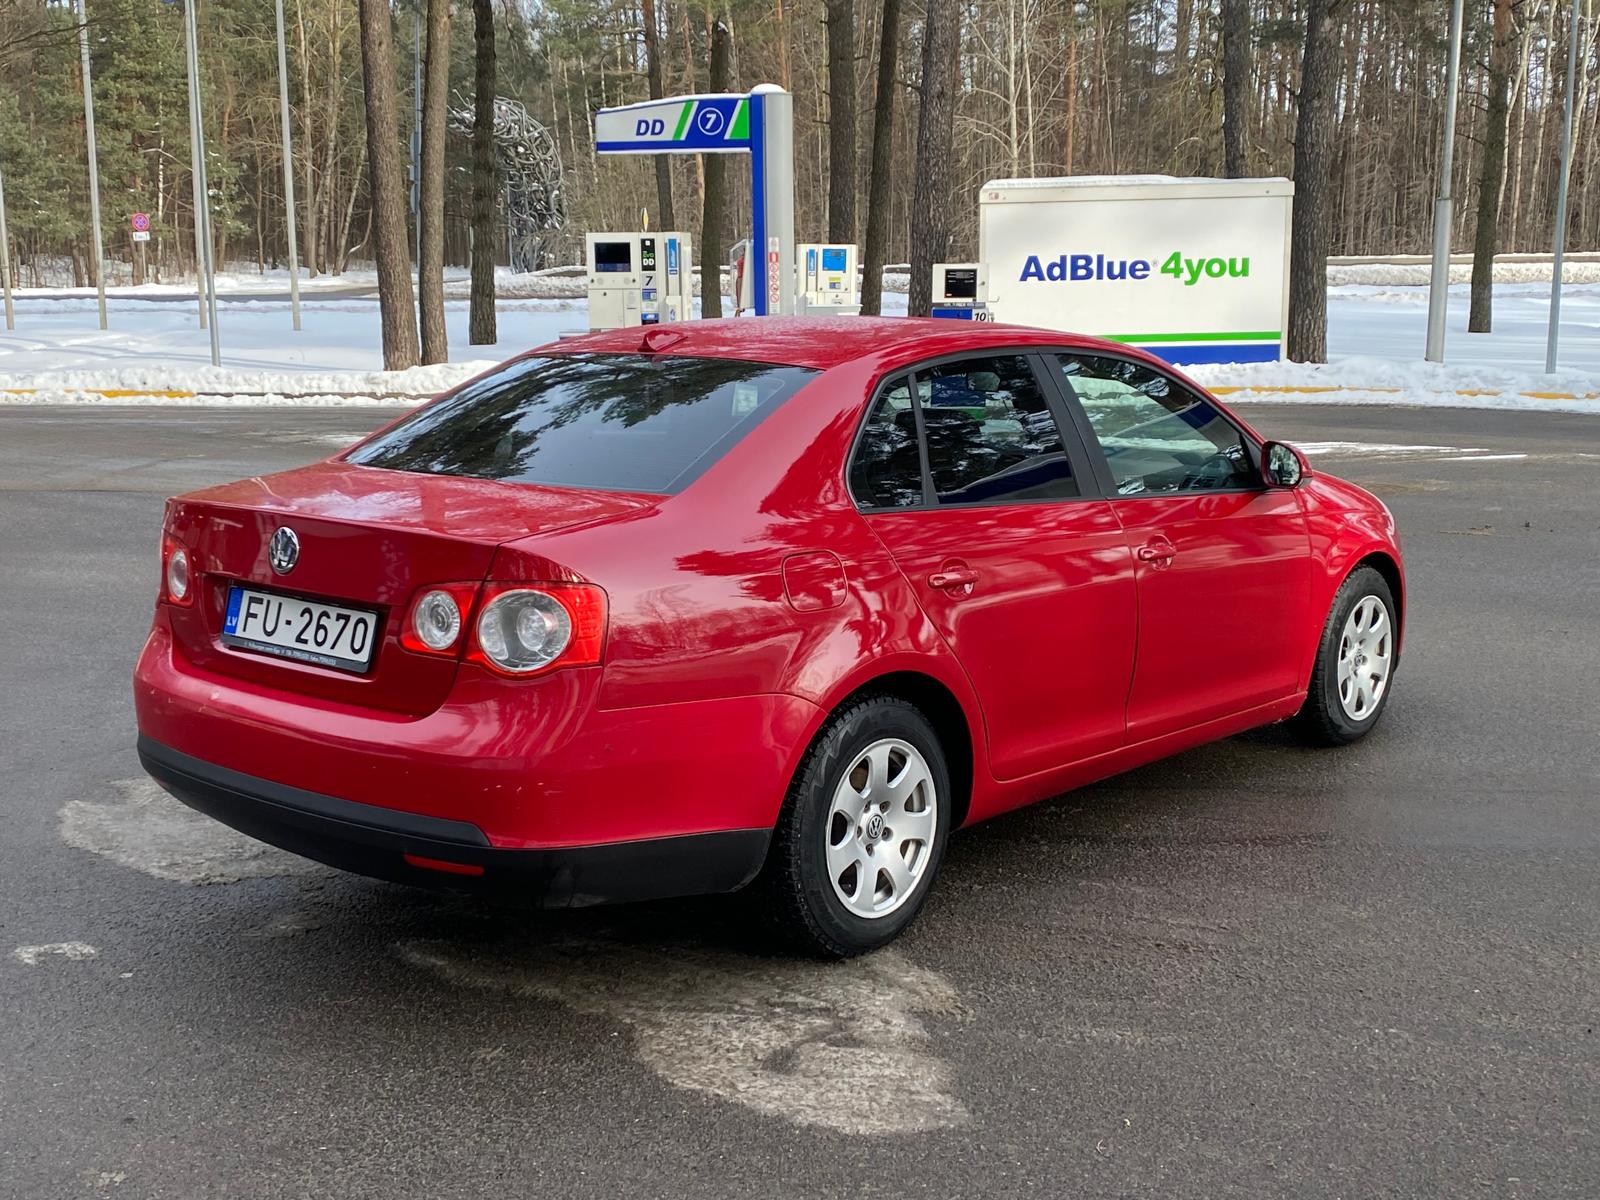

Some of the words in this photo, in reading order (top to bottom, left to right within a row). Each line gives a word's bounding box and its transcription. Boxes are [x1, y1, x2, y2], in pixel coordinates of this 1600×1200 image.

[635, 119, 665, 136] DD
[705, 113, 717, 130] 7
[1160, 251, 1250, 286] 4you
[645, 275, 653, 286] 7
[974, 312, 987, 322] 10
[226, 616, 238, 627] LV
[242, 596, 369, 655] FU-2670
